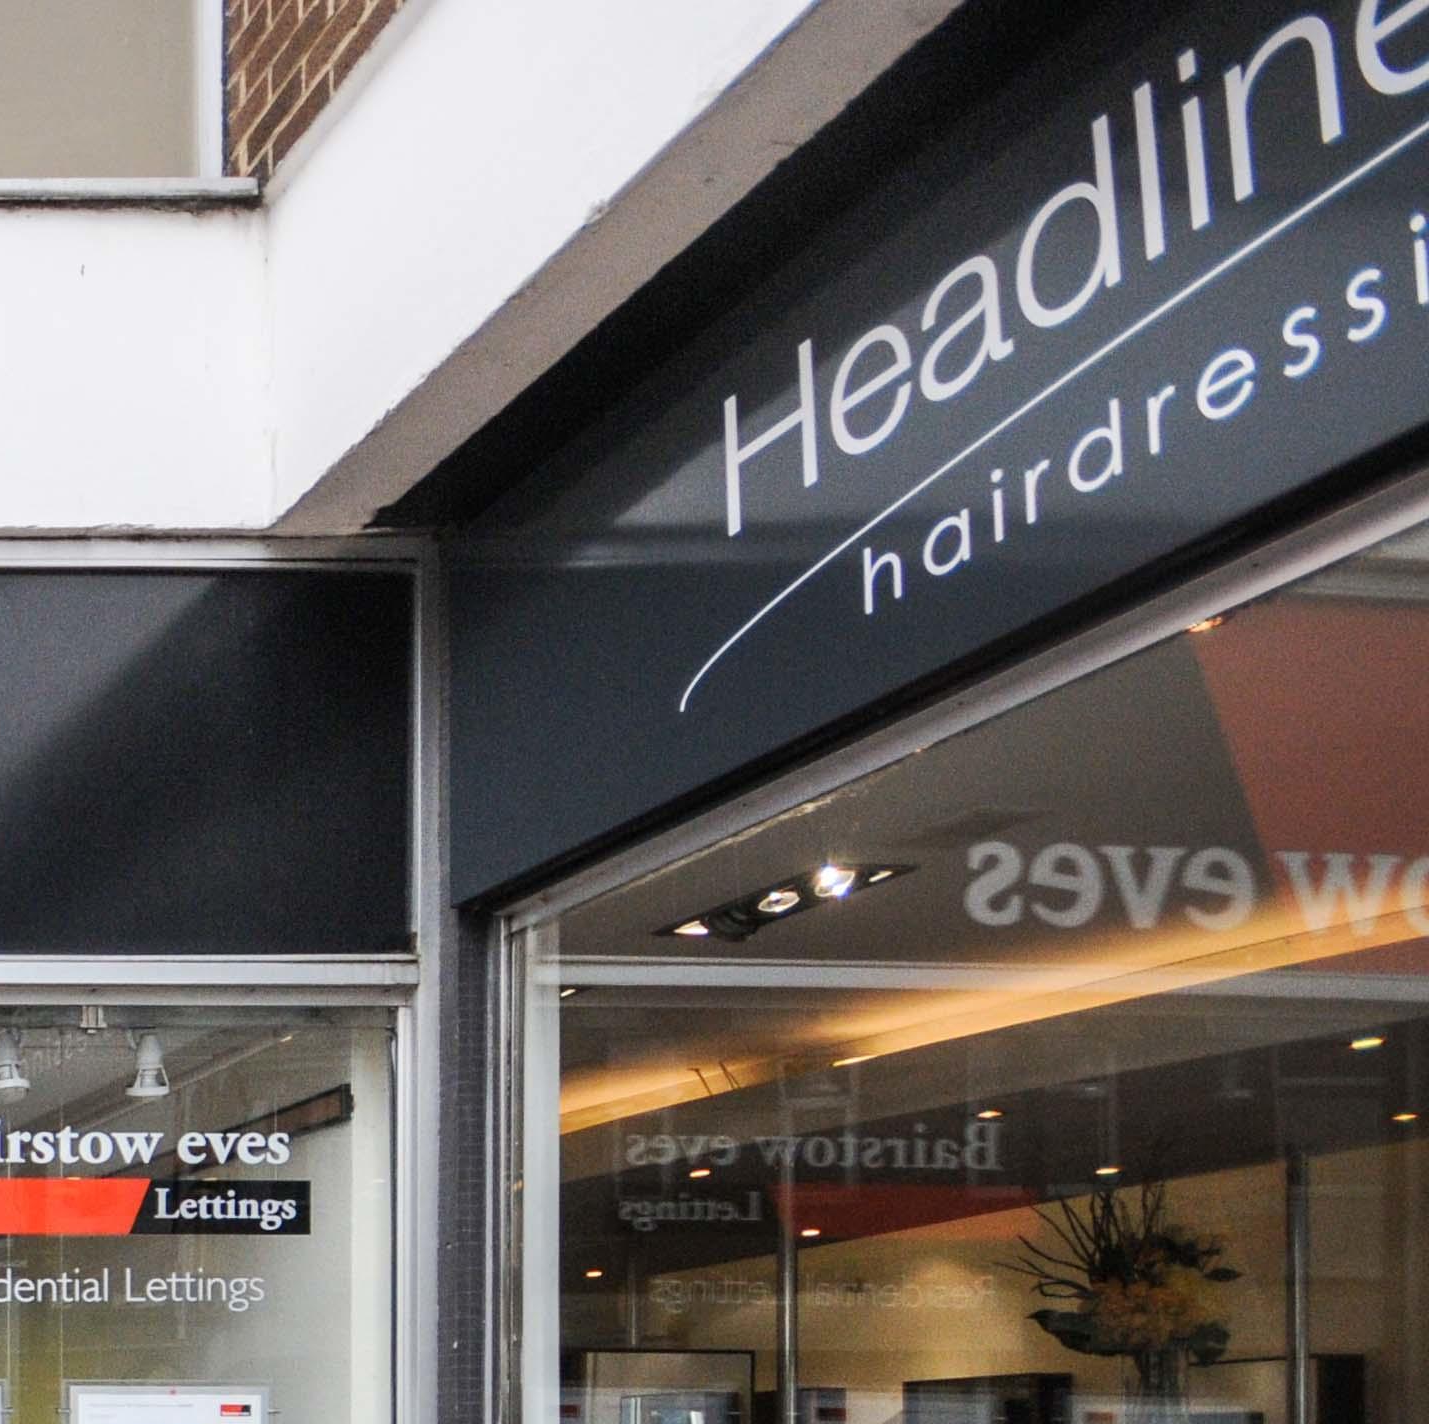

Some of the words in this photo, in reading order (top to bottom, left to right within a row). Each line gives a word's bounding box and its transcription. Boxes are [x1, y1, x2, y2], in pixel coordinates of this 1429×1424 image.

[862, 211, 1429, 616] hairdressi
[177, 1130, 291, 1165] eves
[153, 1187, 297, 1231] Lettings
[125, 1266, 266, 1312] Lettings
